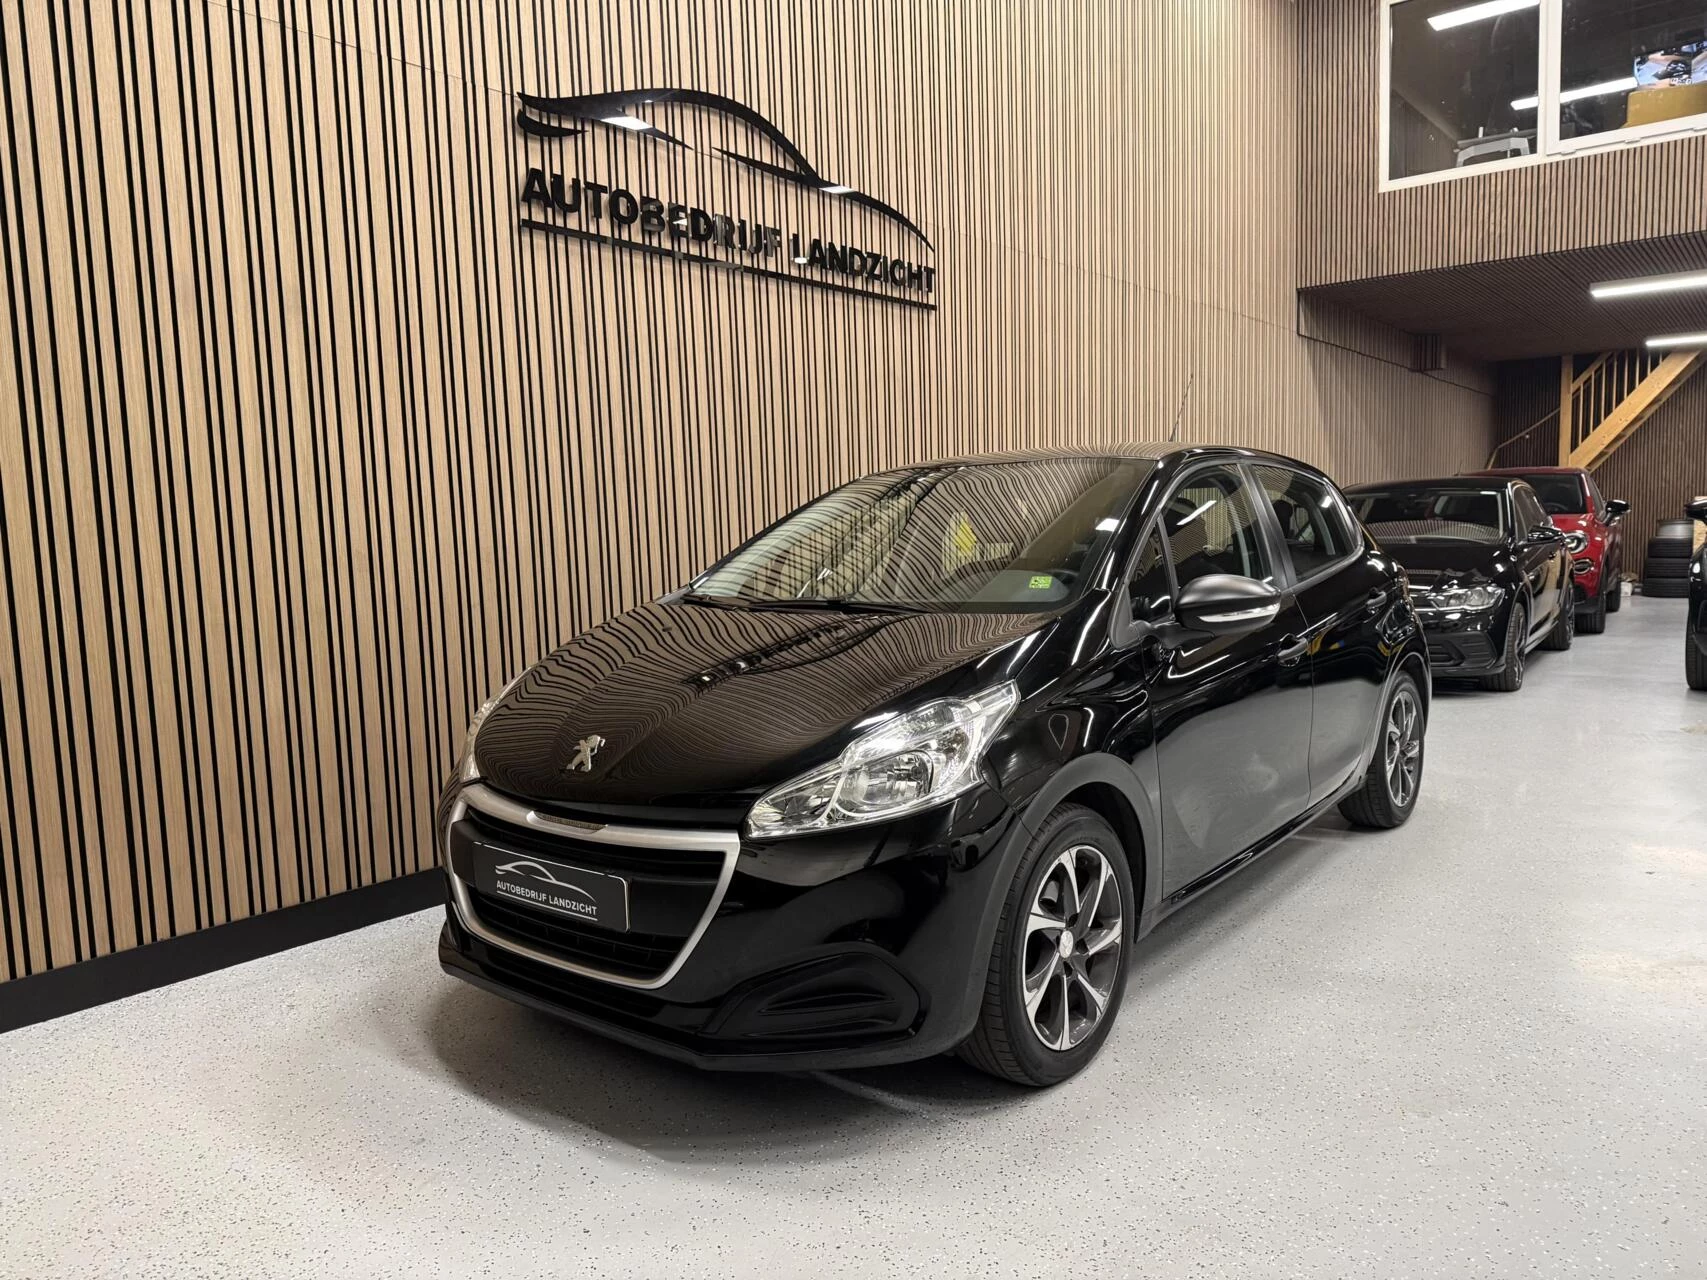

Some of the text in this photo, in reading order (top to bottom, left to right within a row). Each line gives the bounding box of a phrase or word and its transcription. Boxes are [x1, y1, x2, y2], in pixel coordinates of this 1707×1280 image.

[521, 167, 936, 293] AUTOBEDRIJF LANDZICHT
[496, 880, 597, 916] AUTOBEDRIJF LANDZICHT
